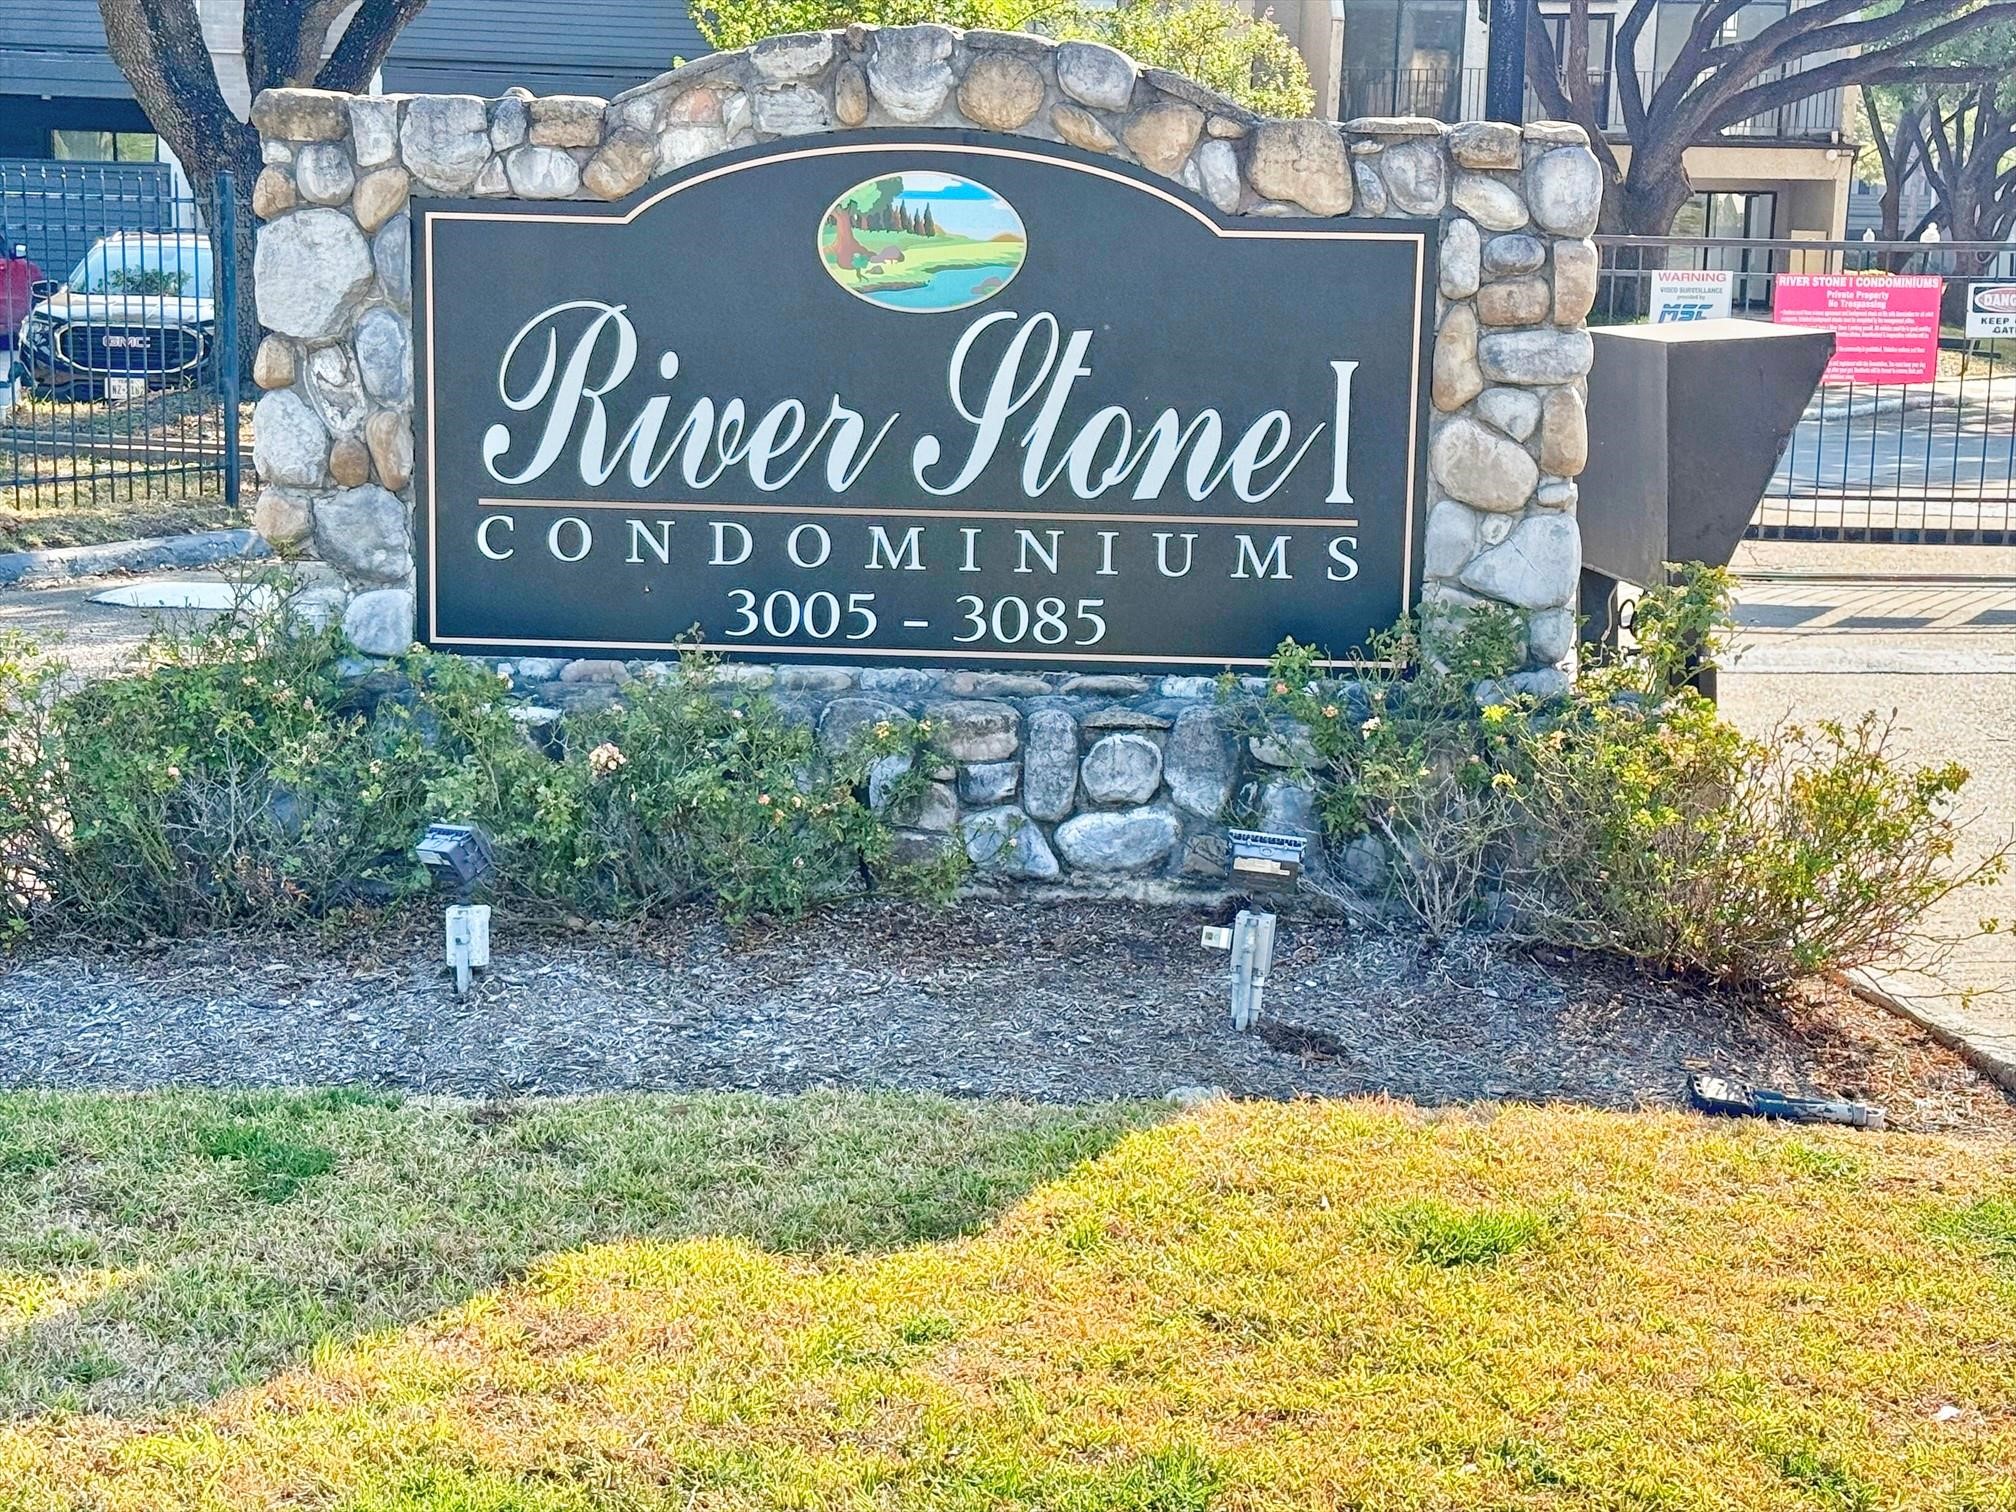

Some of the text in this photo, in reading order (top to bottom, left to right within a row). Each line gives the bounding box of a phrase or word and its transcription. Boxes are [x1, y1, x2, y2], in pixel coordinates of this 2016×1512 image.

[1658, 272, 1727, 282] WARNING
[1778, 277, 1939, 289] RIVER STONE I CONDOMINIUMS
[1660, 286, 1723, 294] VIDEO SURVEILLANCE
[1826, 290, 1889, 301] Private Property
[1828, 299, 1887, 310] No Trespassing
[1981, 317, 2010, 325] KEEP
[1992, 326, 2016, 334] GAT
[102, 335, 151, 349] GMC
[482, 300, 1360, 504] River Stone I
[476, 515, 1359, 582] CONDOMINIUMS
[724, 589, 877, 640] 3005
[953, 595, 1106, 646] 3085
